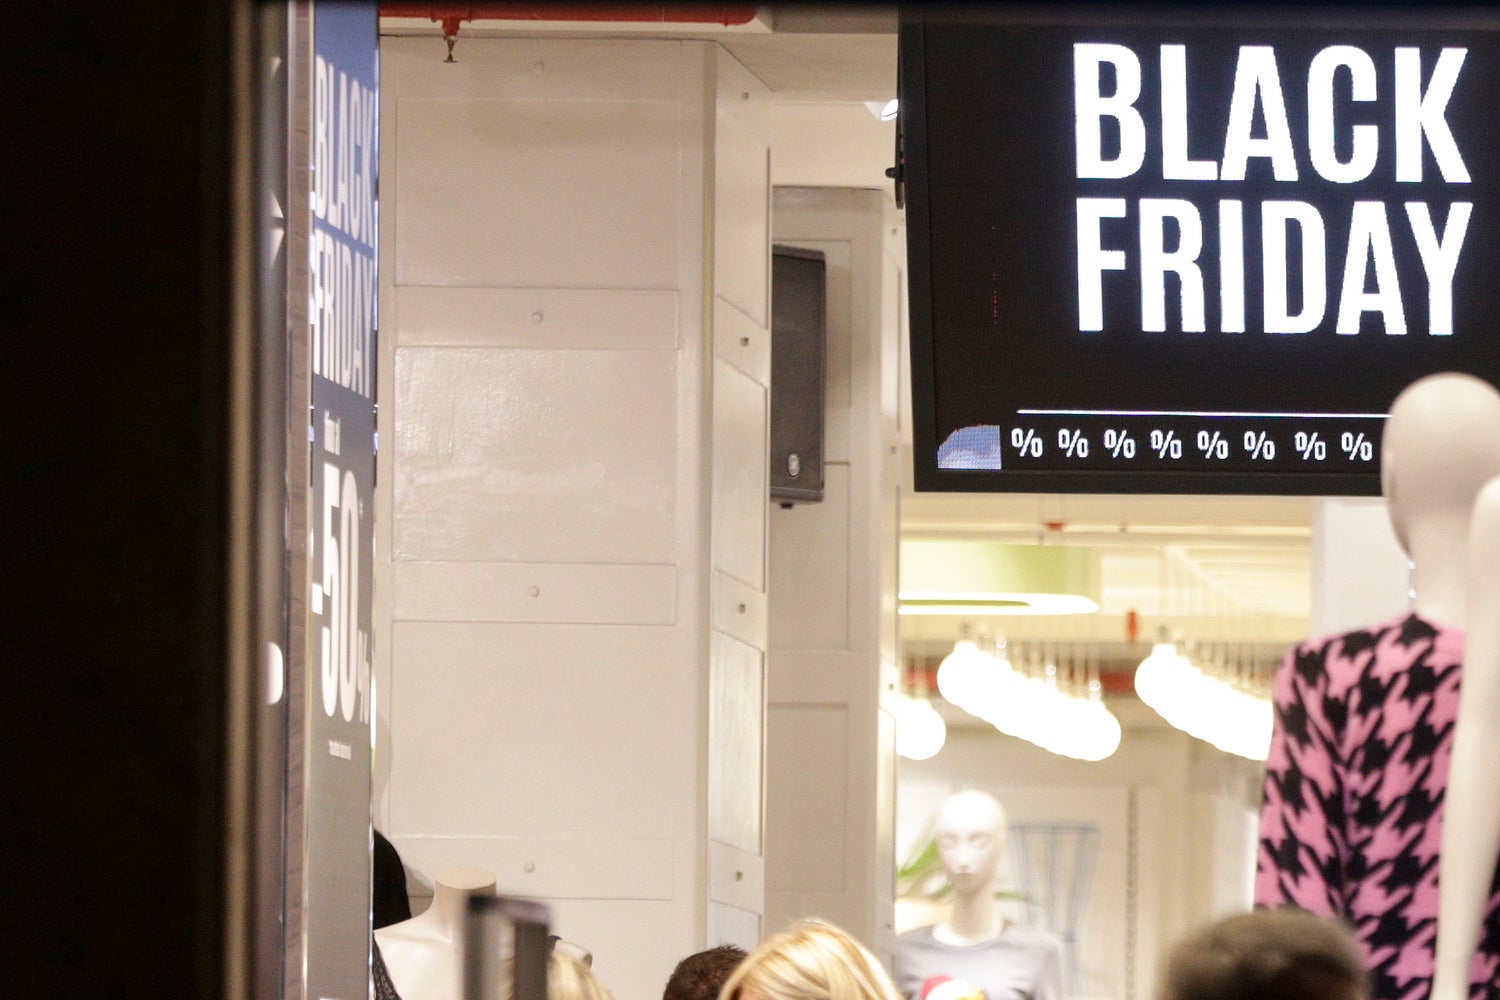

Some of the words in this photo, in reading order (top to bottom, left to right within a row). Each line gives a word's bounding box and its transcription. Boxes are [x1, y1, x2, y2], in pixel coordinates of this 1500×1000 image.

[314, 54, 374, 250] BLACK
[1073, 42, 1472, 184] BLACK
[313, 226, 374, 400] FRIDAY
[1075, 198, 1474, 336] FRIDAY
[1011, 427, 1043, 458] %
[1058, 428, 1089, 459] %
[1104, 428, 1136, 459] %
[1150, 429, 1182, 460] %
[1197, 430, 1229, 461] %
[1243, 430, 1275, 461] %
[1294, 431, 1326, 461] %
[1341, 431, 1373, 462] %
